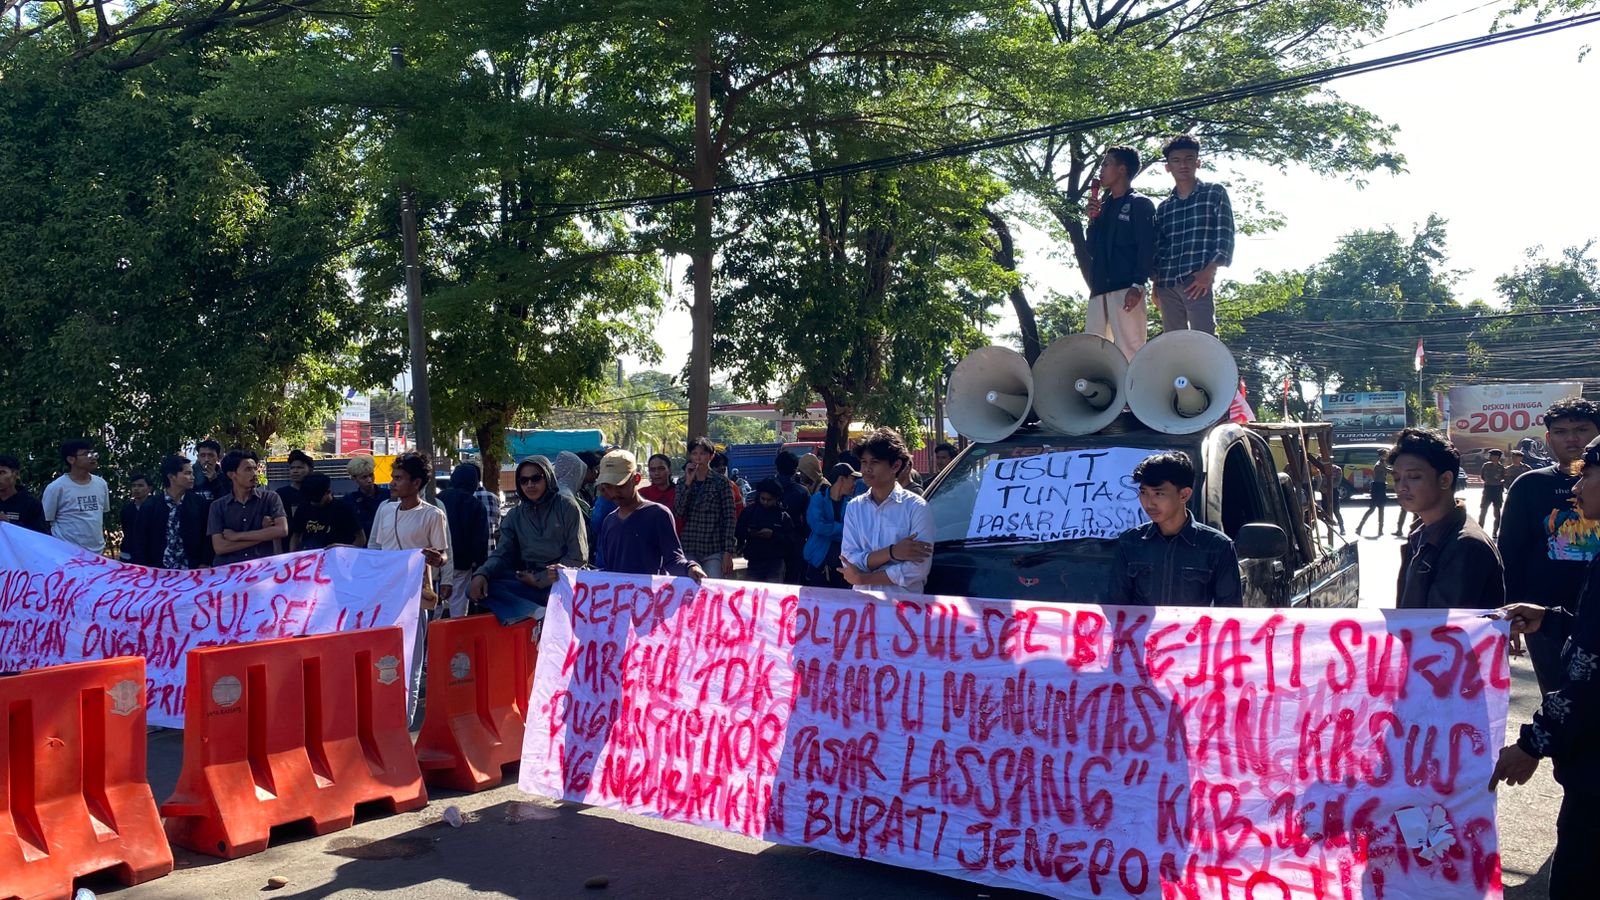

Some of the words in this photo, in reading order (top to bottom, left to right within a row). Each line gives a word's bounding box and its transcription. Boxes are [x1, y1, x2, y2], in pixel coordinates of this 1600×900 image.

[1328, 394, 1355, 403] BIG
[1482, 403, 1511, 412] DISKON
[1512, 401, 1543, 410] HINGGA
[994, 452, 1109, 483] USUT
[77, 495, 97, 504] FEAR
[80, 503, 98, 511] LESS
[997, 475, 1139, 509] TUNTAS
[976, 510, 1054, 534] PASAR
[776, 595, 879, 661] POLDA
[561, 640, 680, 700] KARENA
[693, 653, 778, 709] TDK
[790, 657, 926, 733] MAMPU
[1297, 708, 1484, 796] KASUS
[792, 725, 888, 793] PASAR
[803, 790, 949, 858] BUPATI
